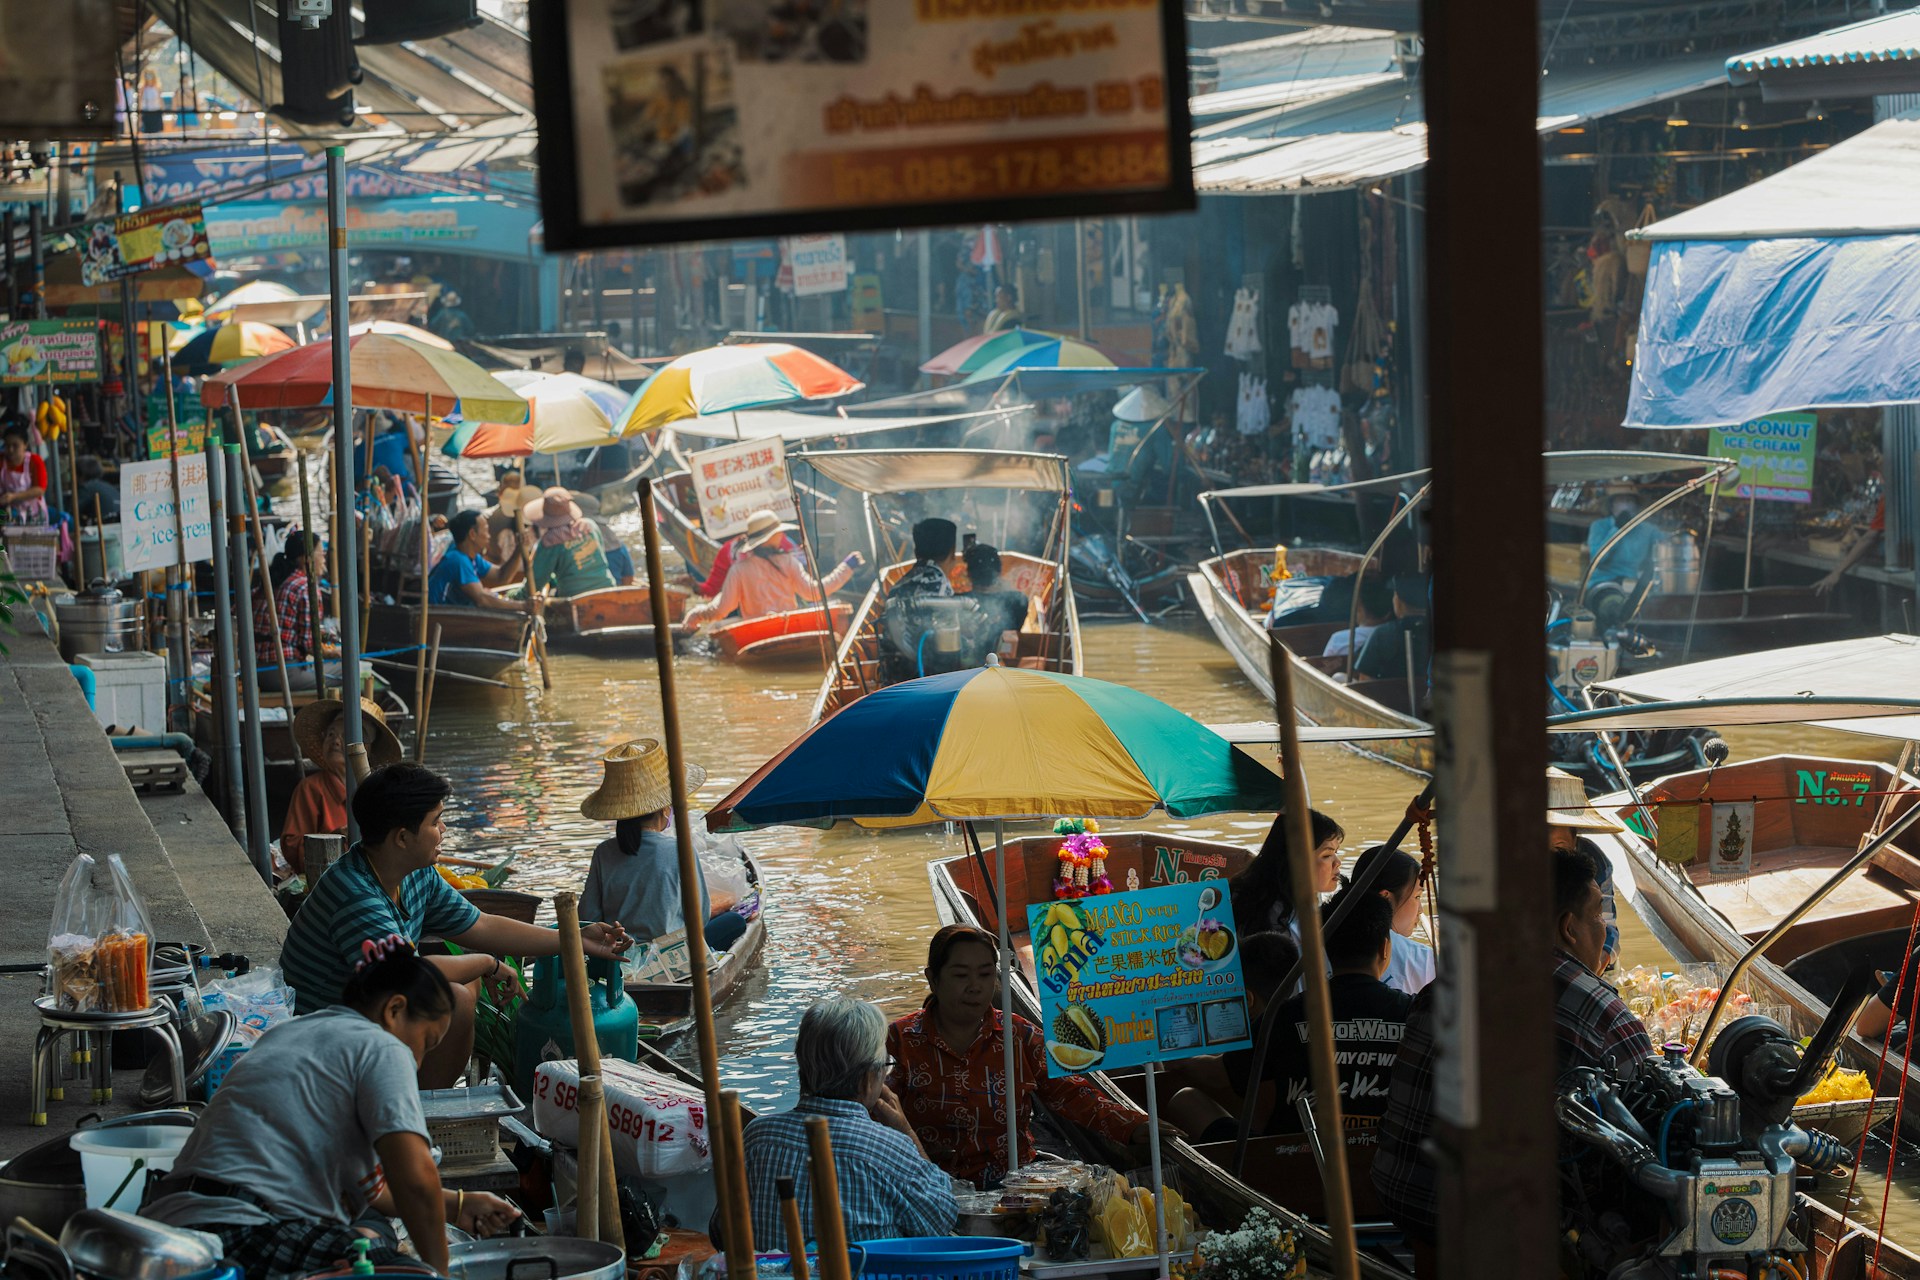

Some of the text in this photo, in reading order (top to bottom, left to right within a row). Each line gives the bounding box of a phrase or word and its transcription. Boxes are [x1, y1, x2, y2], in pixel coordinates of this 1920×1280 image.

[705, 477, 762, 501] Coconut
[1084, 900, 1178, 935] MANGO WITH
[1110, 923, 1184, 947] STICK RICE
[1092, 947, 1179, 975] 芒果糯米饭
[1206, 973, 1235, 987] 100
[1105, 1012, 1156, 1047] Durian
[609, 1103, 675, 1142] SB912
